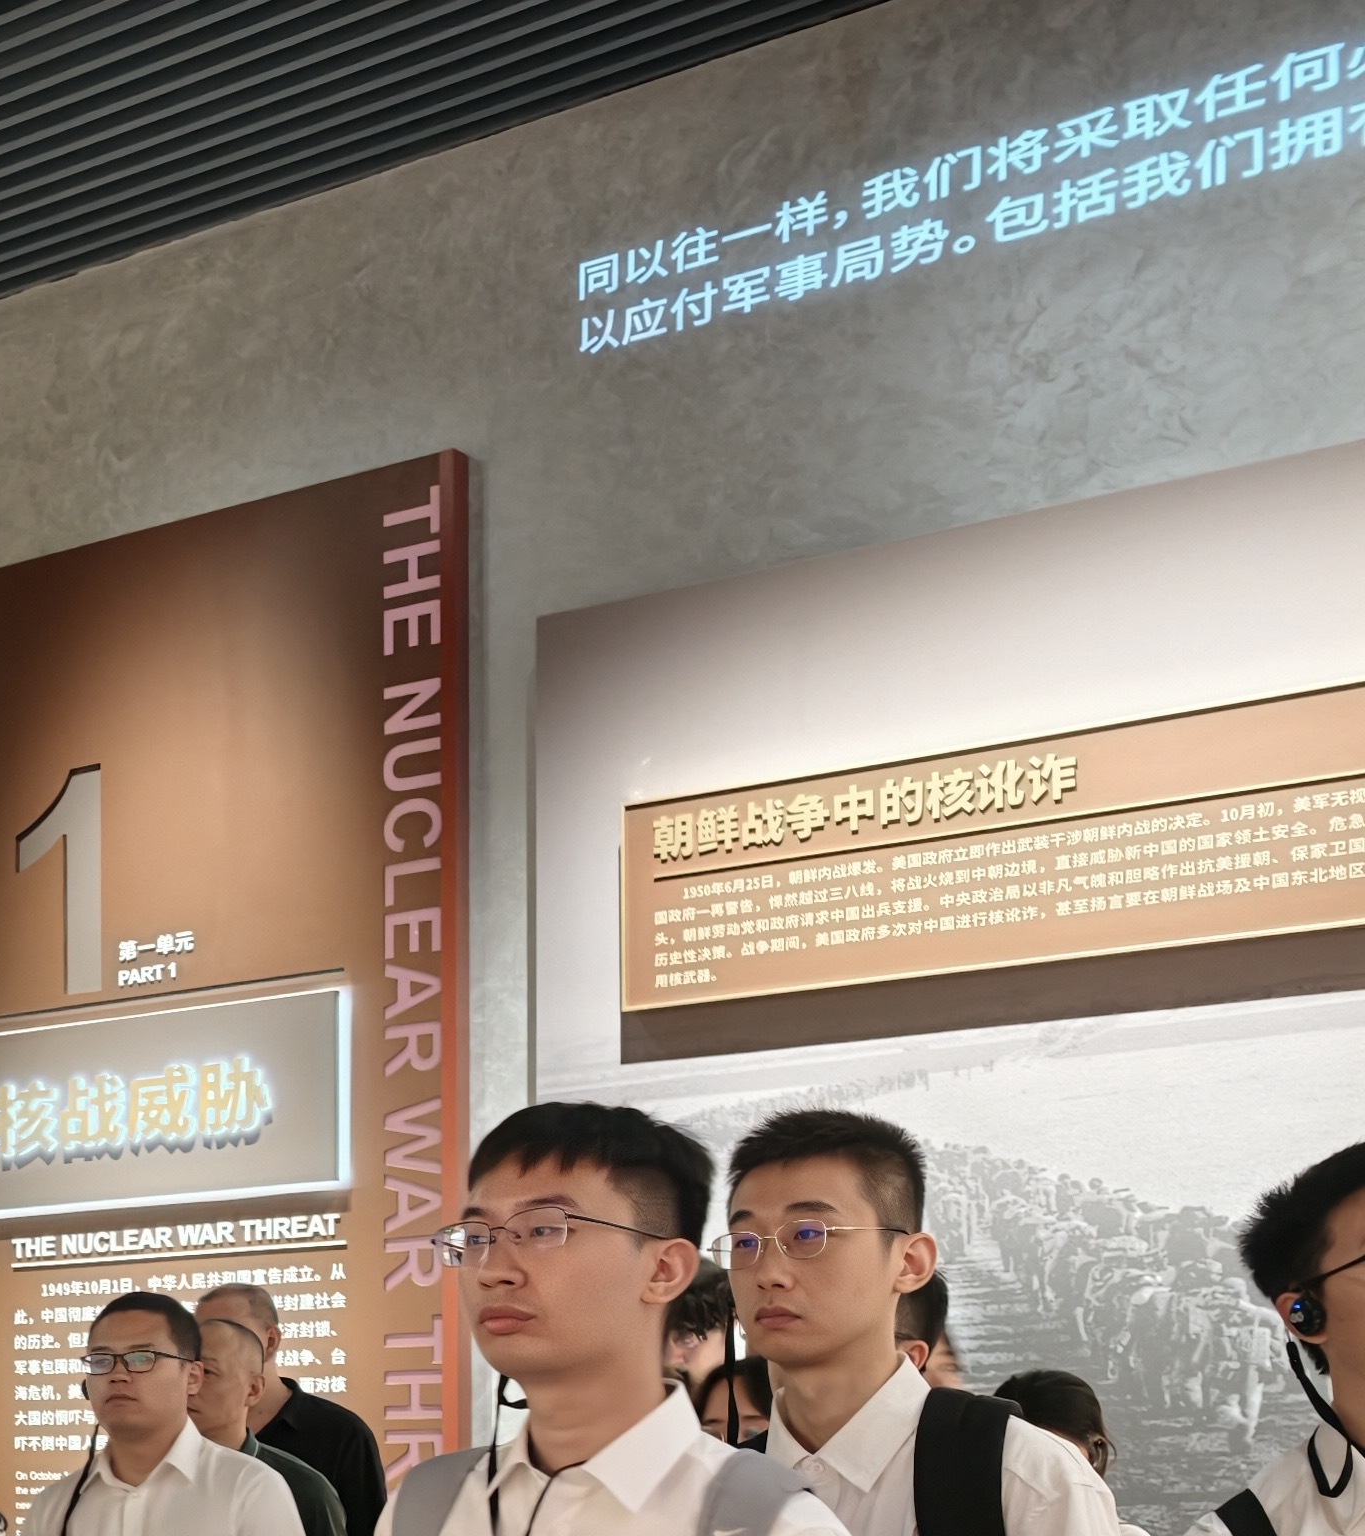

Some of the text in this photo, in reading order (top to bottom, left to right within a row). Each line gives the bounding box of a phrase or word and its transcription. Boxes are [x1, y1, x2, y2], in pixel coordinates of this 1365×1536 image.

[577, 42, 1365, 301] 同以往一样，我们将采取任何
[577, 102, 1365, 354] 以应付军事局势。包括我们拥
[382, 485, 441, 656] THE
[16, 763, 101, 994] 1
[382, 677, 442, 1079] NUCLEAR
[653, 753, 1078, 861] 朝鲜战争中的核讹诈
[117, 961, 177, 987] PART 1
[118, 931, 195, 961] 第一单元
[11, 1213, 341, 1259] THE NUCLEAR WAR THREAT
[383, 1098, 442, 1293] WAR
